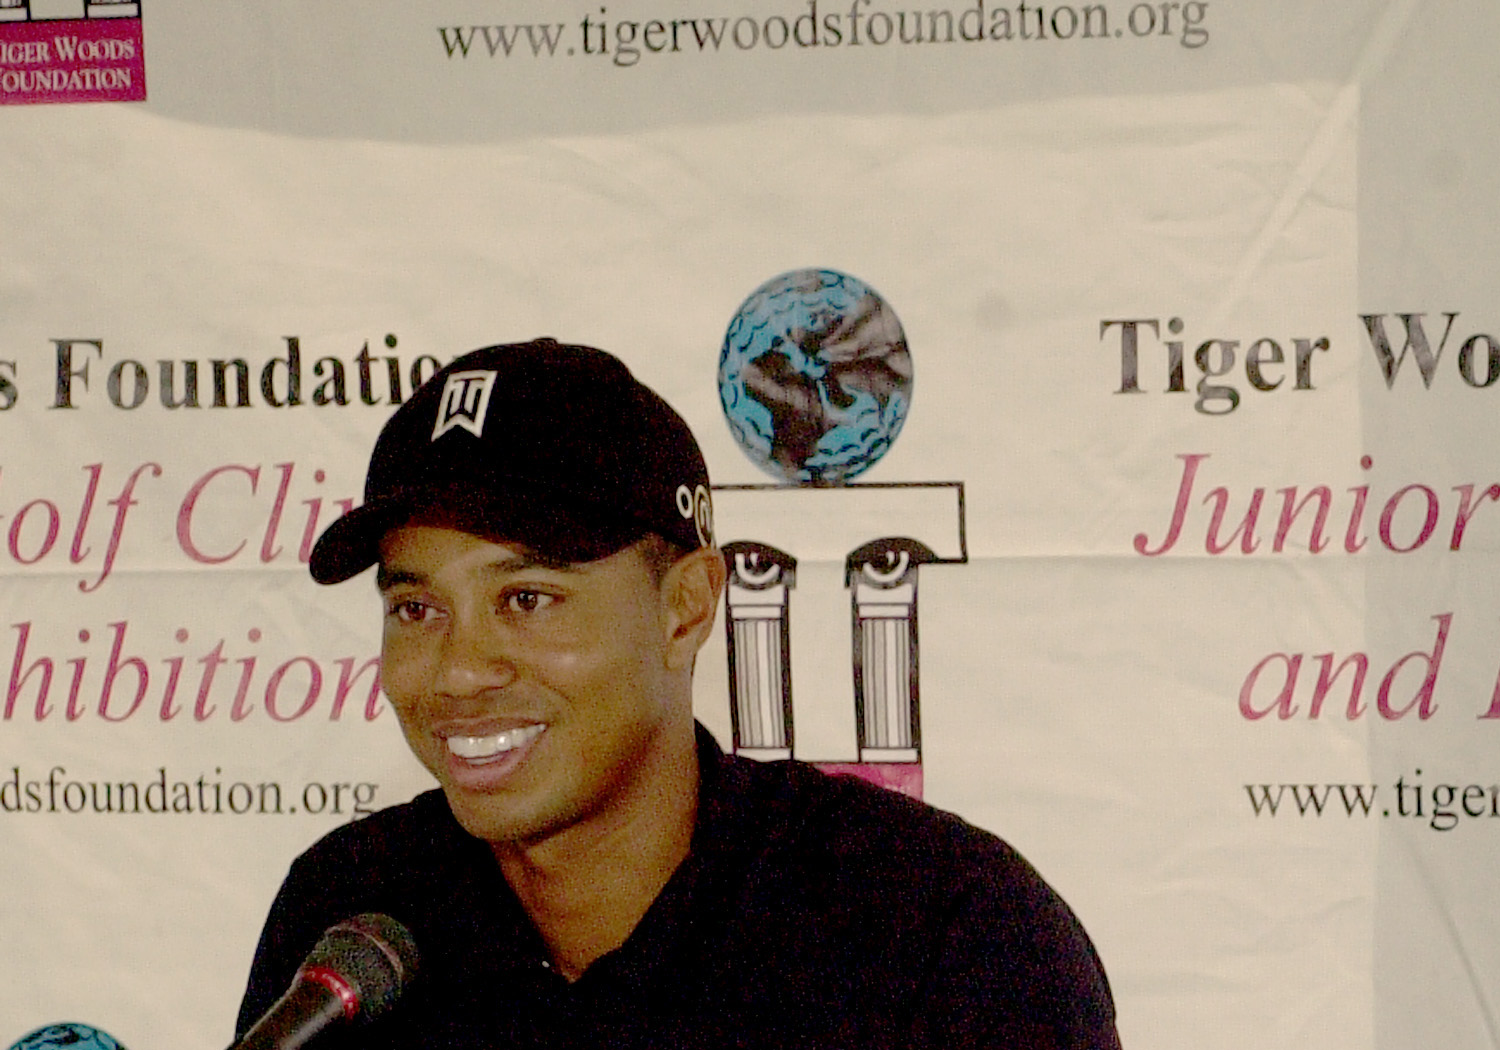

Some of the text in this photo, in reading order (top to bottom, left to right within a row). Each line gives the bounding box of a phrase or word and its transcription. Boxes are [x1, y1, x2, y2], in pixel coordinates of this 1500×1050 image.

[0, 41, 50, 64] IGER
[437, 0, 1210, 67] www.tigerwoodsfoundation.org
[0, 68, 132, 92] OUNDATION
[48, 333, 444, 410] Foundatio
[1100, 317, 1330, 416] Tiger
[0, 462, 163, 593] olf
[1238, 612, 1454, 721] and
